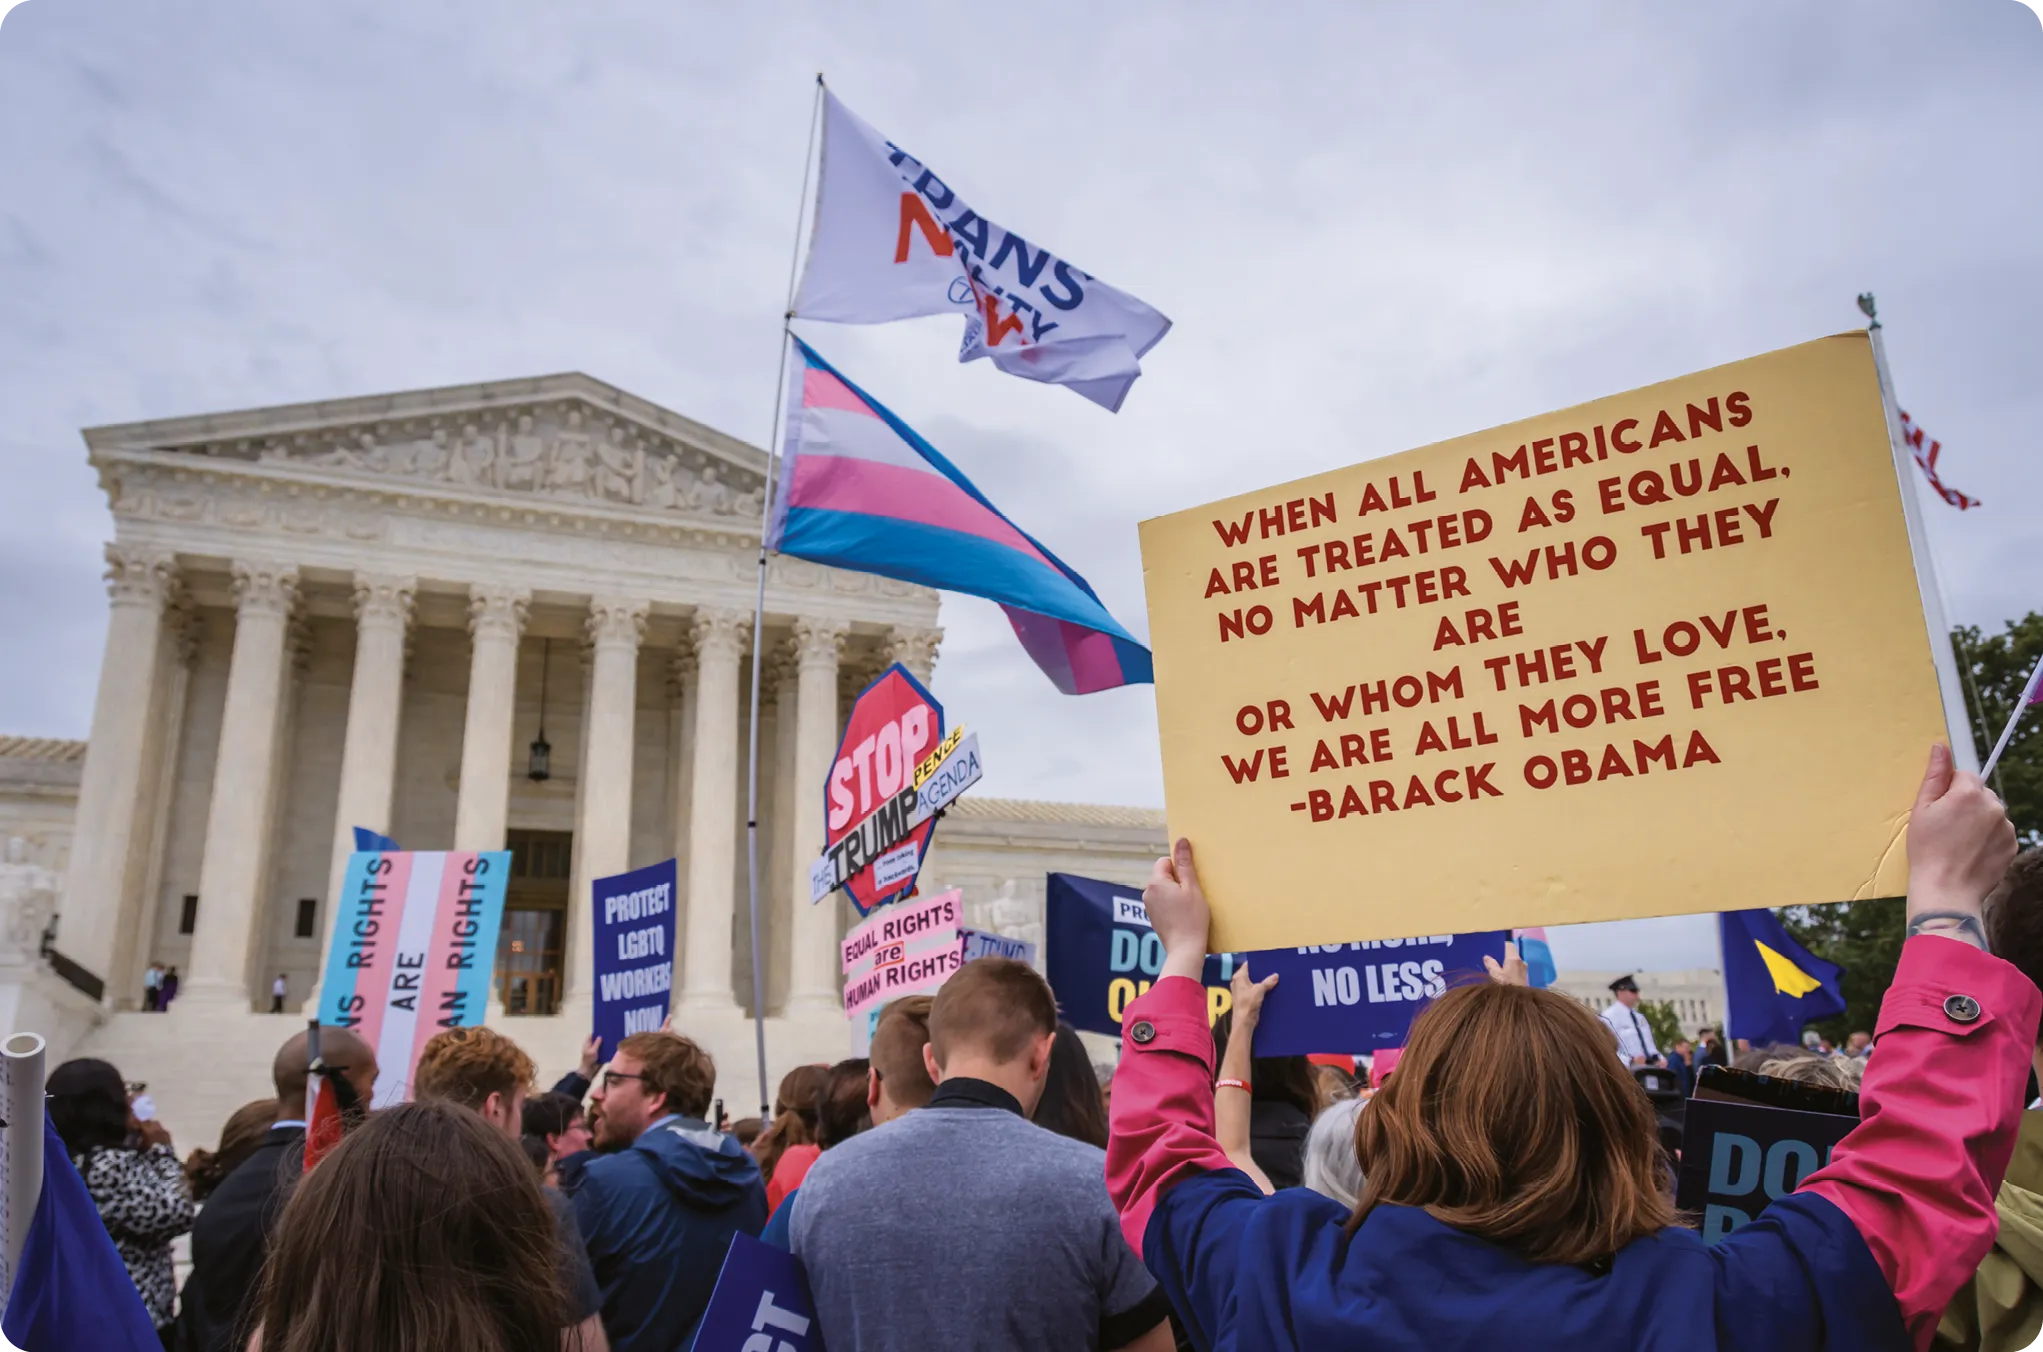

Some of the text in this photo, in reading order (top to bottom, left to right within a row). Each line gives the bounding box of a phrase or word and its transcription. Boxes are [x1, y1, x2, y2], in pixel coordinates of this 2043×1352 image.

[1212, 391, 1753, 548] WHEN ALL AMERICANS
[1204, 445, 1790, 599] ARE TREATED AS EQUAL,
[1218, 499, 1779, 643] NO MATTER WHO THEY
[1433, 600, 1524, 652] ARE
[1235, 603, 1787, 736] OR WHOM THEY LOVE,
[1221, 651, 1820, 785] WE ARE ALL MORE FREE
[828, 703, 929, 831] STOP
[914, 727, 961, 787] PENCE
[1290, 729, 1721, 823] -BARACK OBAMA
[827, 785, 918, 884] TRUMP
[918, 751, 979, 814] AGENDA
[346, 858, 393, 969] RIGHTS
[446, 858, 490, 970] RIGHTS
[604, 882, 671, 925] PROTECT
[845, 901, 954, 963] EQUAL RIGHTS
[1119, 902, 1151, 920] PR
[617, 924, 665, 961] LGBTQ
[875, 946, 901, 967] are
[389, 953, 424, 1012] ARE
[600, 961, 672, 1002] WORKERS
[846, 950, 960, 1010] HUMAN RIGHTS
[1311, 959, 1447, 1007] NO LESS
[1707, 1131, 1832, 1201] DO
